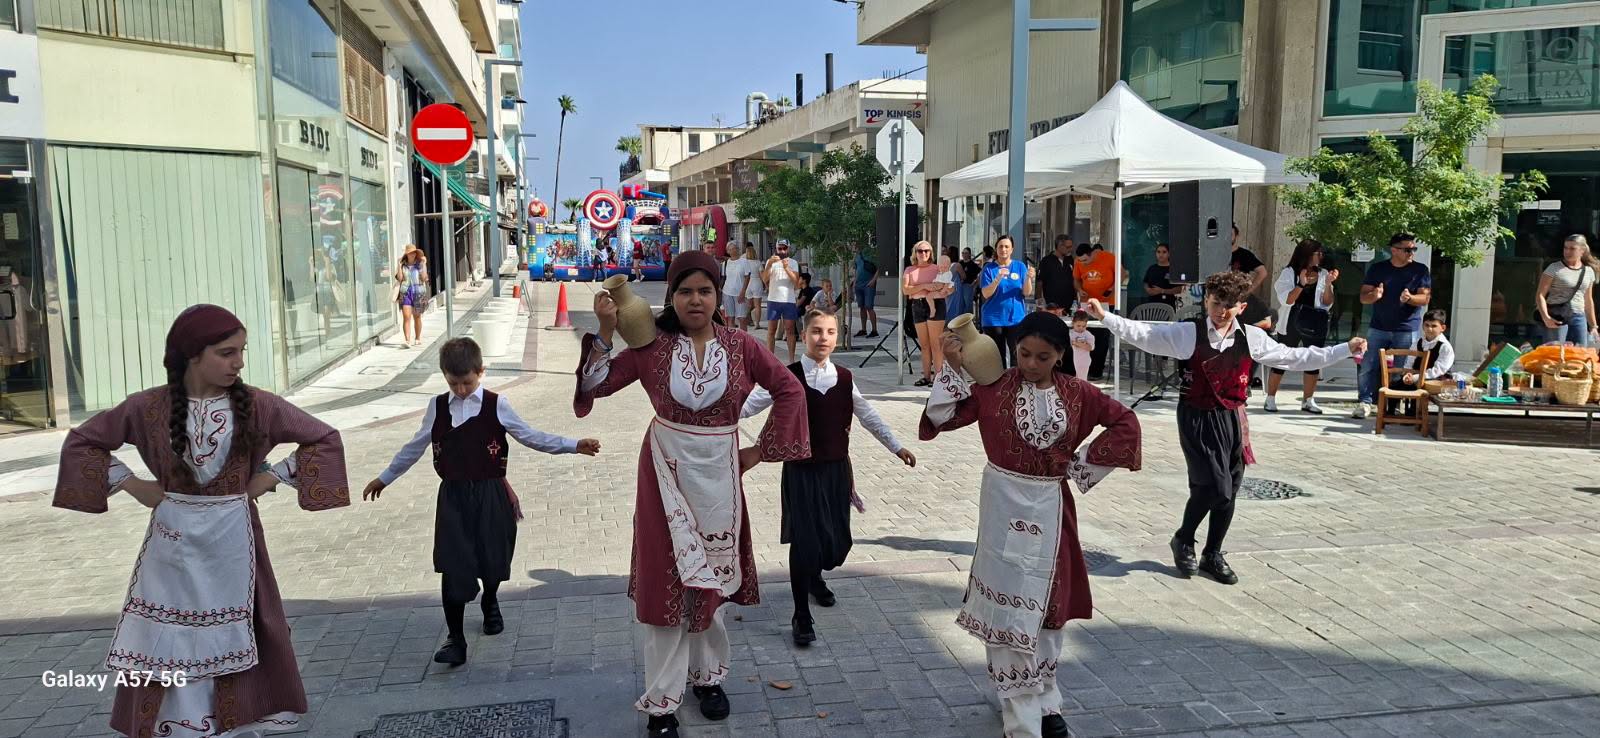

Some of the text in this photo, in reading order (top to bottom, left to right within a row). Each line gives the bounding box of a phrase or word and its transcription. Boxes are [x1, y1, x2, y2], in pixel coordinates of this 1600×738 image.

[864, 109, 922, 119] TOP KINISIS
[299, 119, 331, 152] BIDI
[360, 146, 379, 170] BIDI
